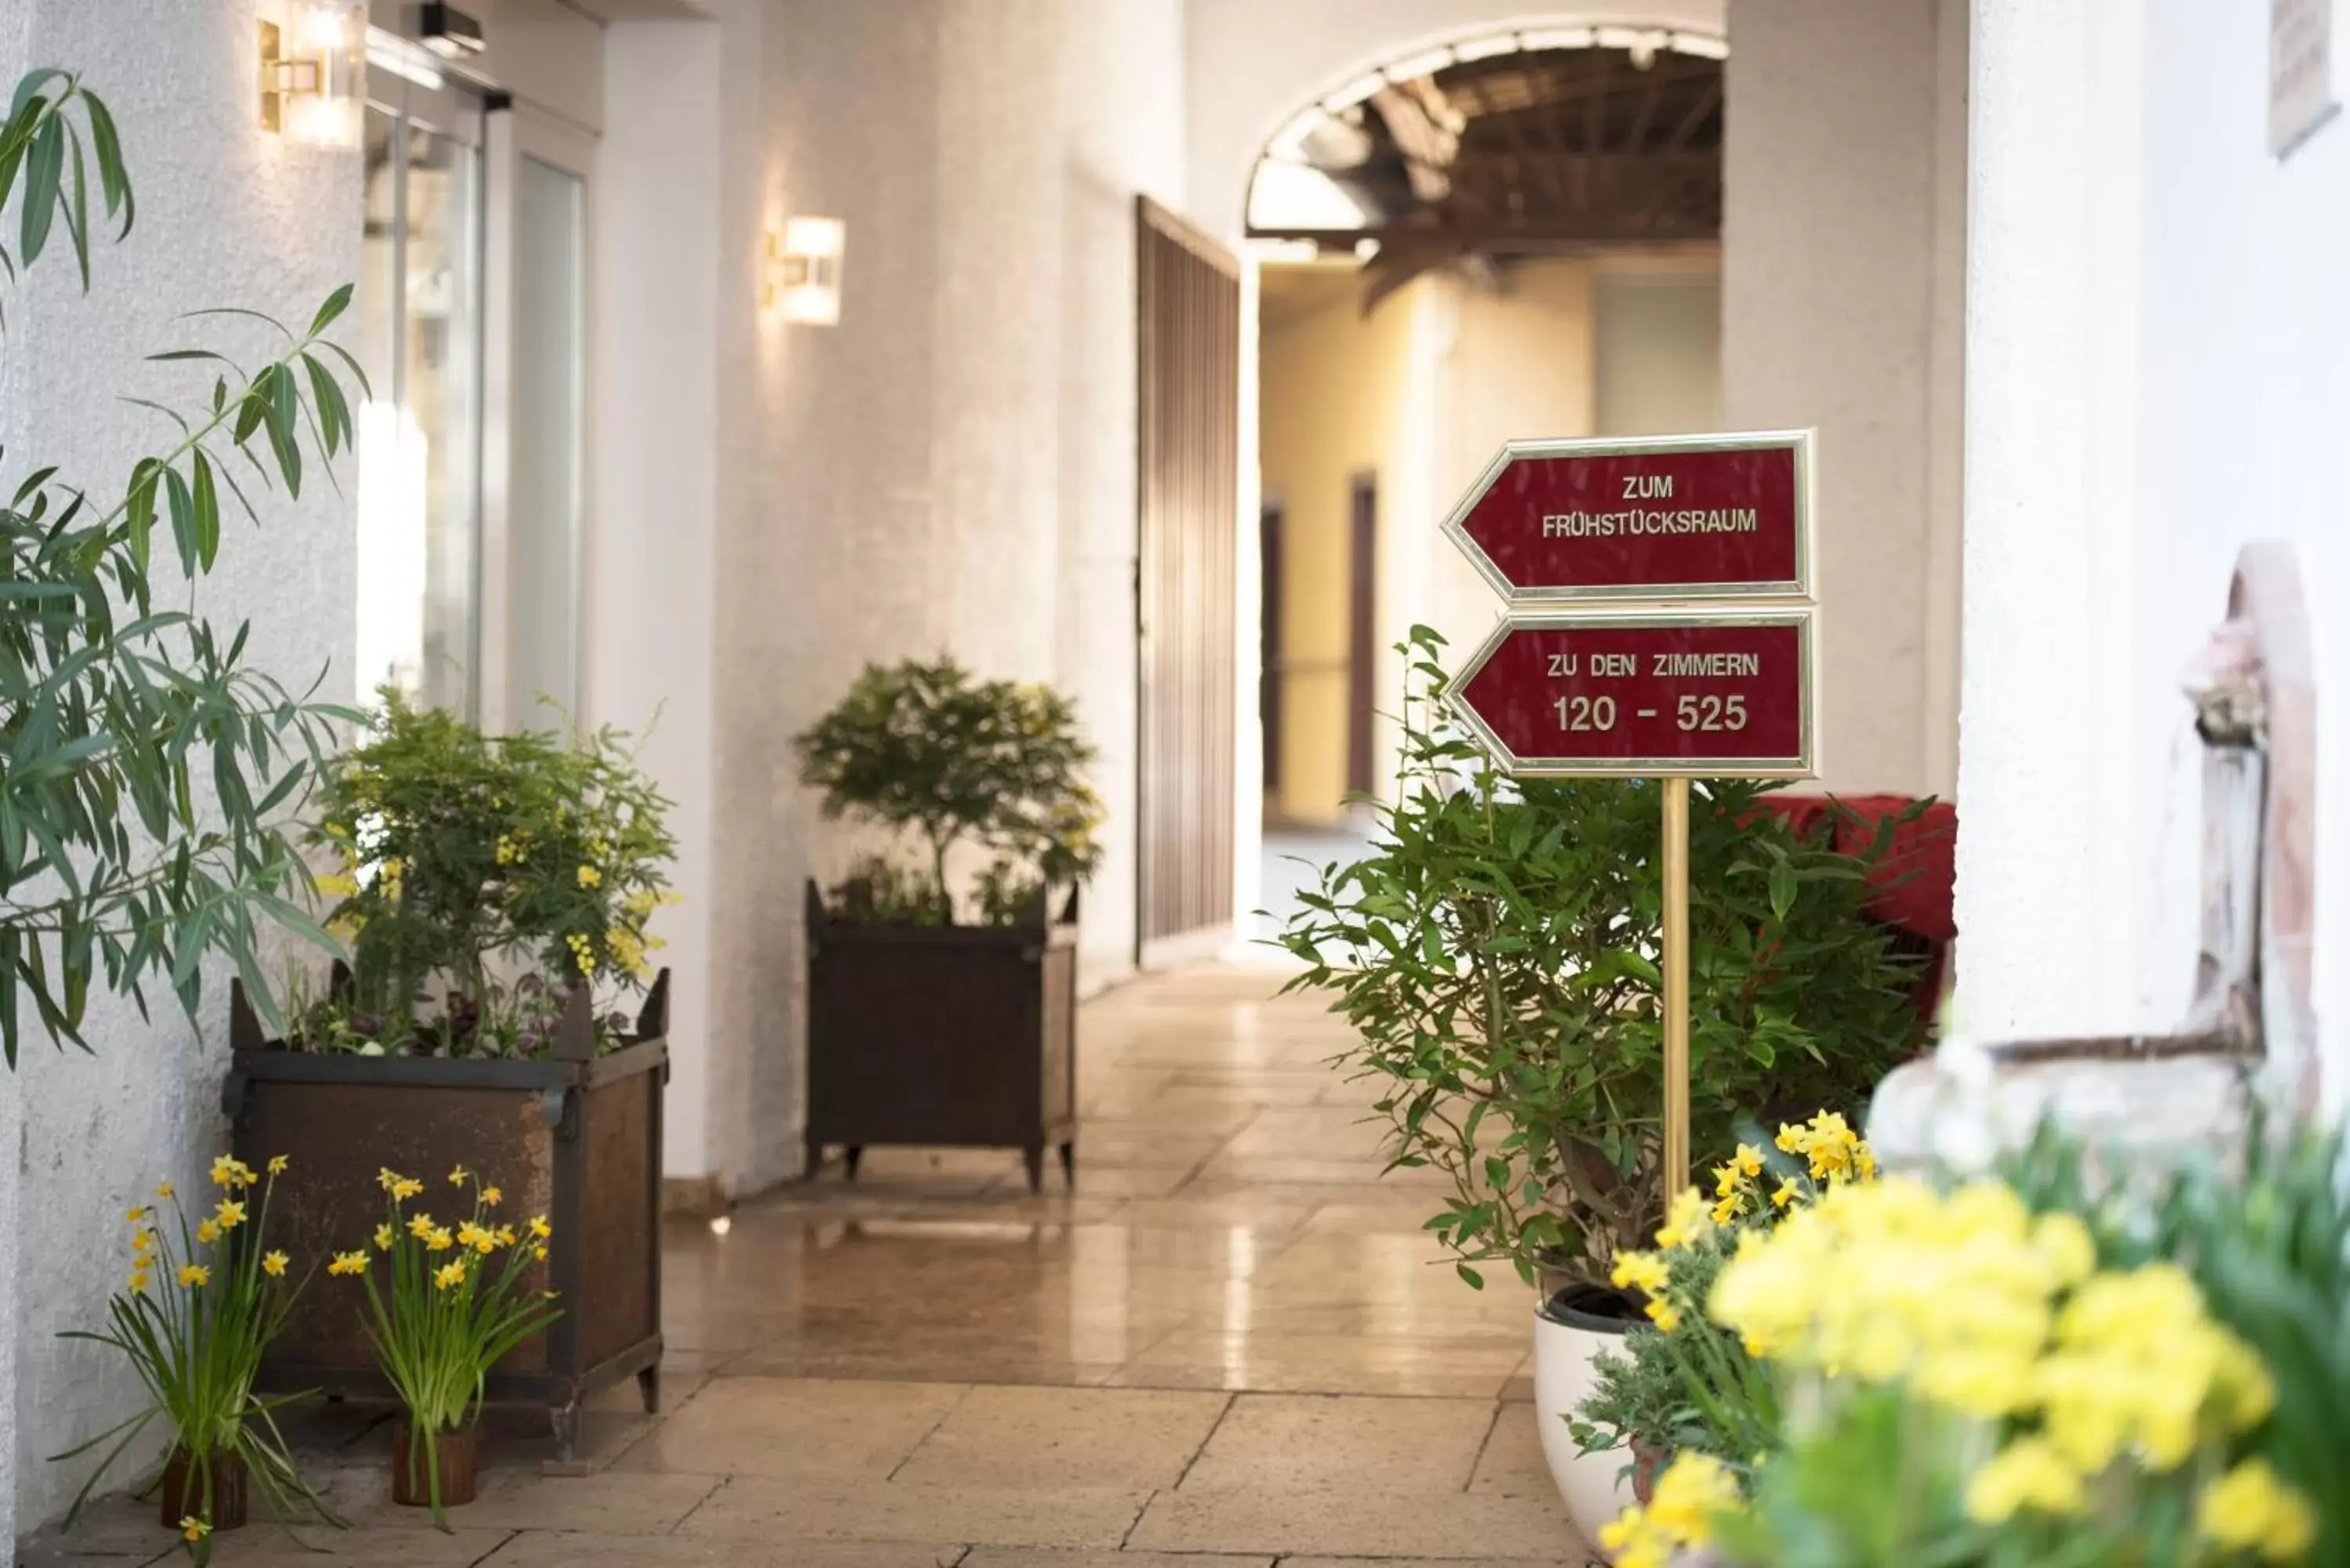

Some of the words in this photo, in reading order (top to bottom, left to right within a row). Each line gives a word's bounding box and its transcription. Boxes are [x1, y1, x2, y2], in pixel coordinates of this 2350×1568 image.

[1622, 475, 1672, 499] ZUM
[1542, 508, 1756, 538] FRÜHSTÜCKSRAUM
[1547, 654, 1577, 677] ZU
[1590, 653, 1636, 677] DEN
[1652, 652, 1759, 677] ZIMMERN
[1553, 695, 1616, 731] 120
[1676, 695, 1747, 731] 525
